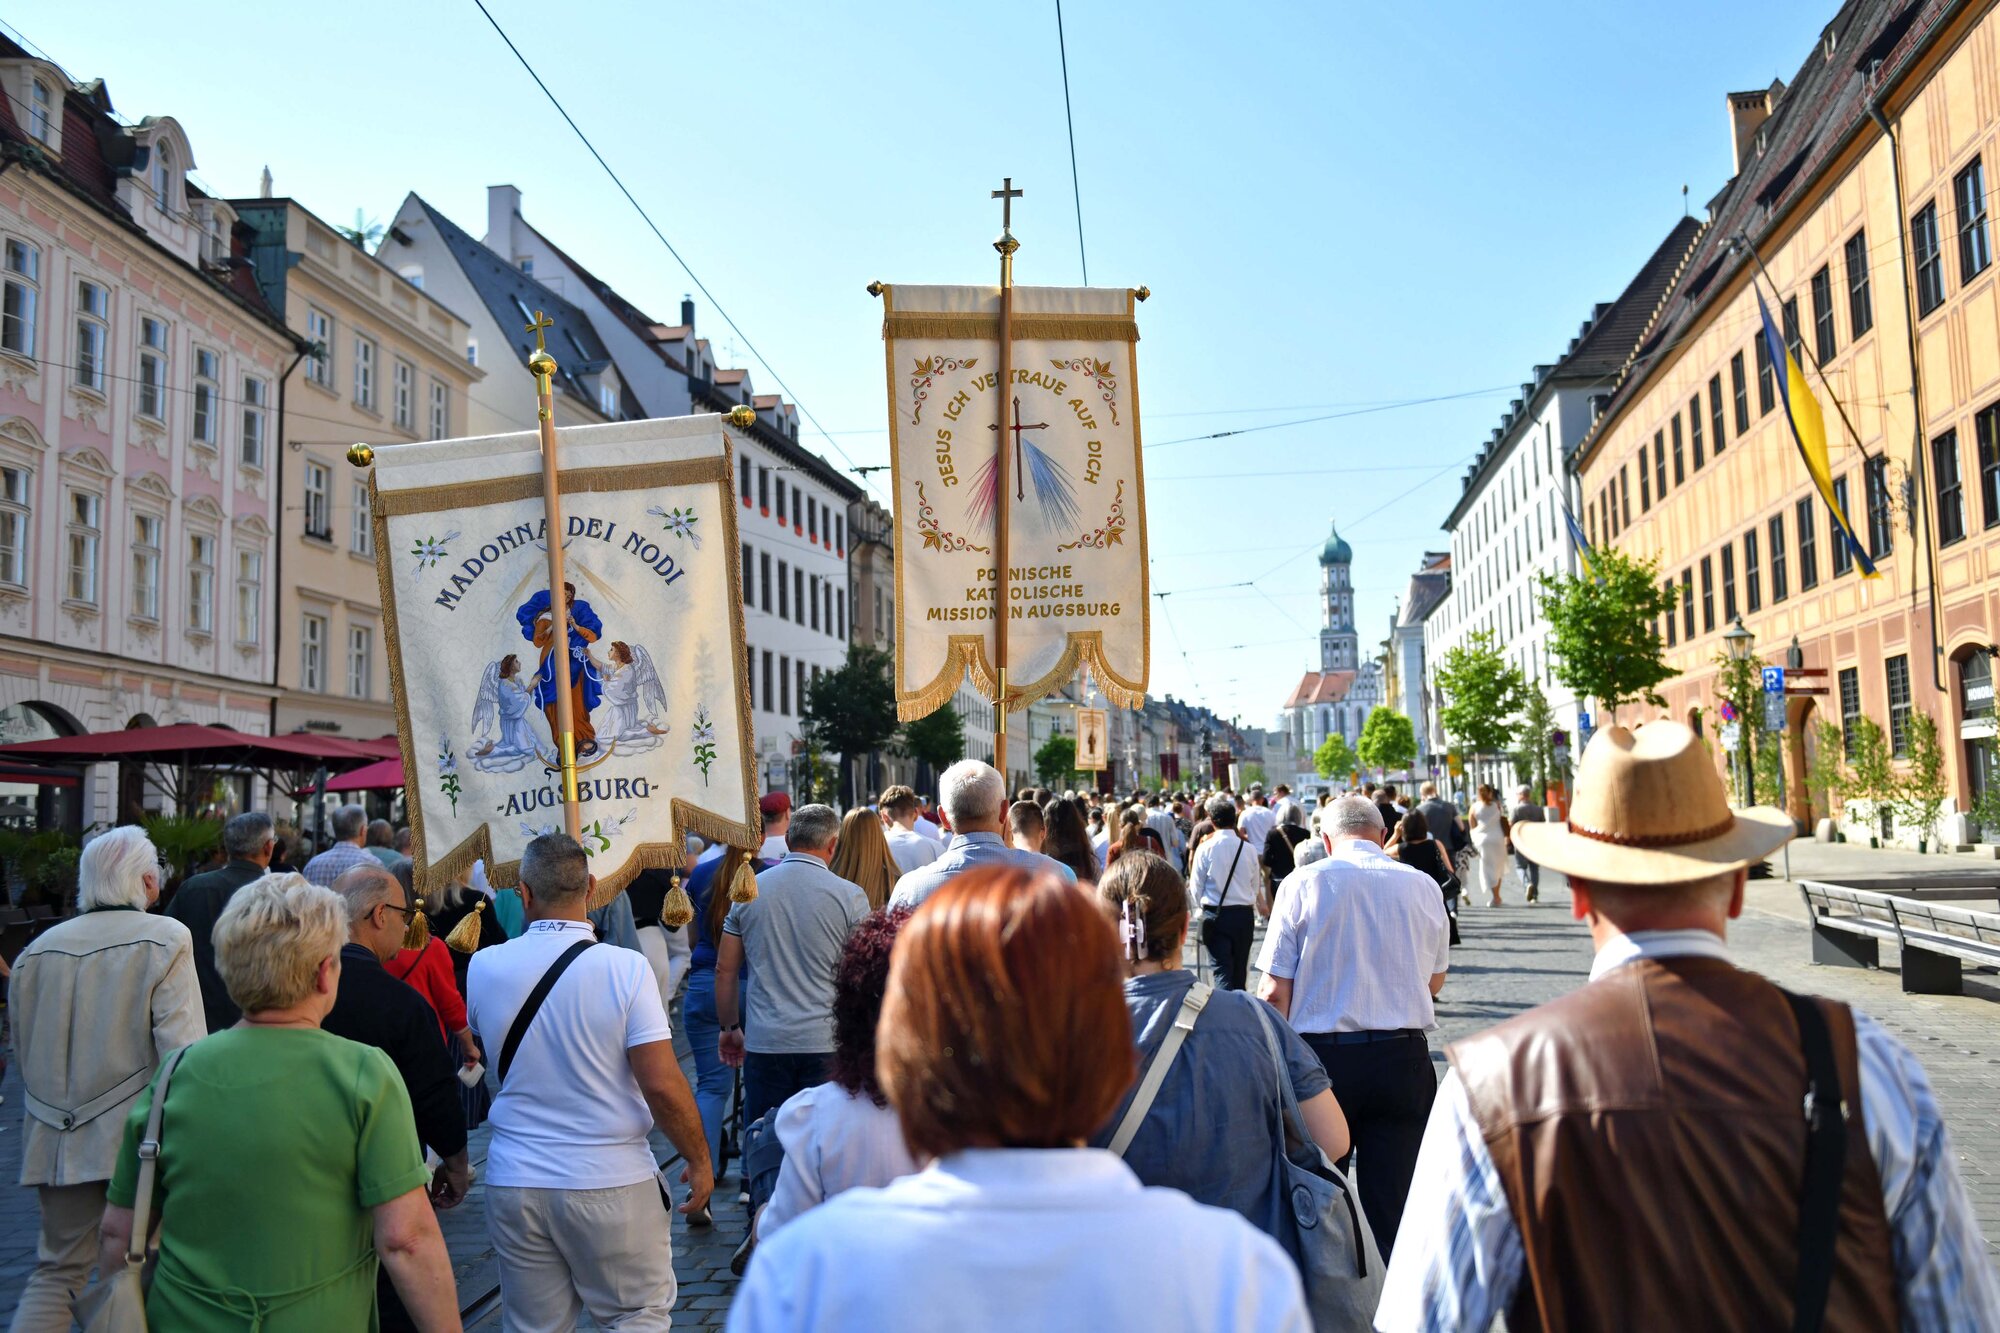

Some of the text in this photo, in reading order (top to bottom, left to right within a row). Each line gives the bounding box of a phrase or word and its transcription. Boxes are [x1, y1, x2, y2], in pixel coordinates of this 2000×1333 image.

[943, 390, 971, 421] ICH
[1068, 398, 1097, 431] AUF
[936, 429, 959, 487] JESUS
[1084, 440, 1102, 485] DICH
[567, 516, 617, 543] DEI
[622, 531, 685, 586] NODI
[976, 565, 1072, 581] PONISCHE
[966, 584, 1084, 601] KATOLISCHE
[1027, 602, 1121, 619] AUGSBURG
[539, 921, 567, 932] EA7
